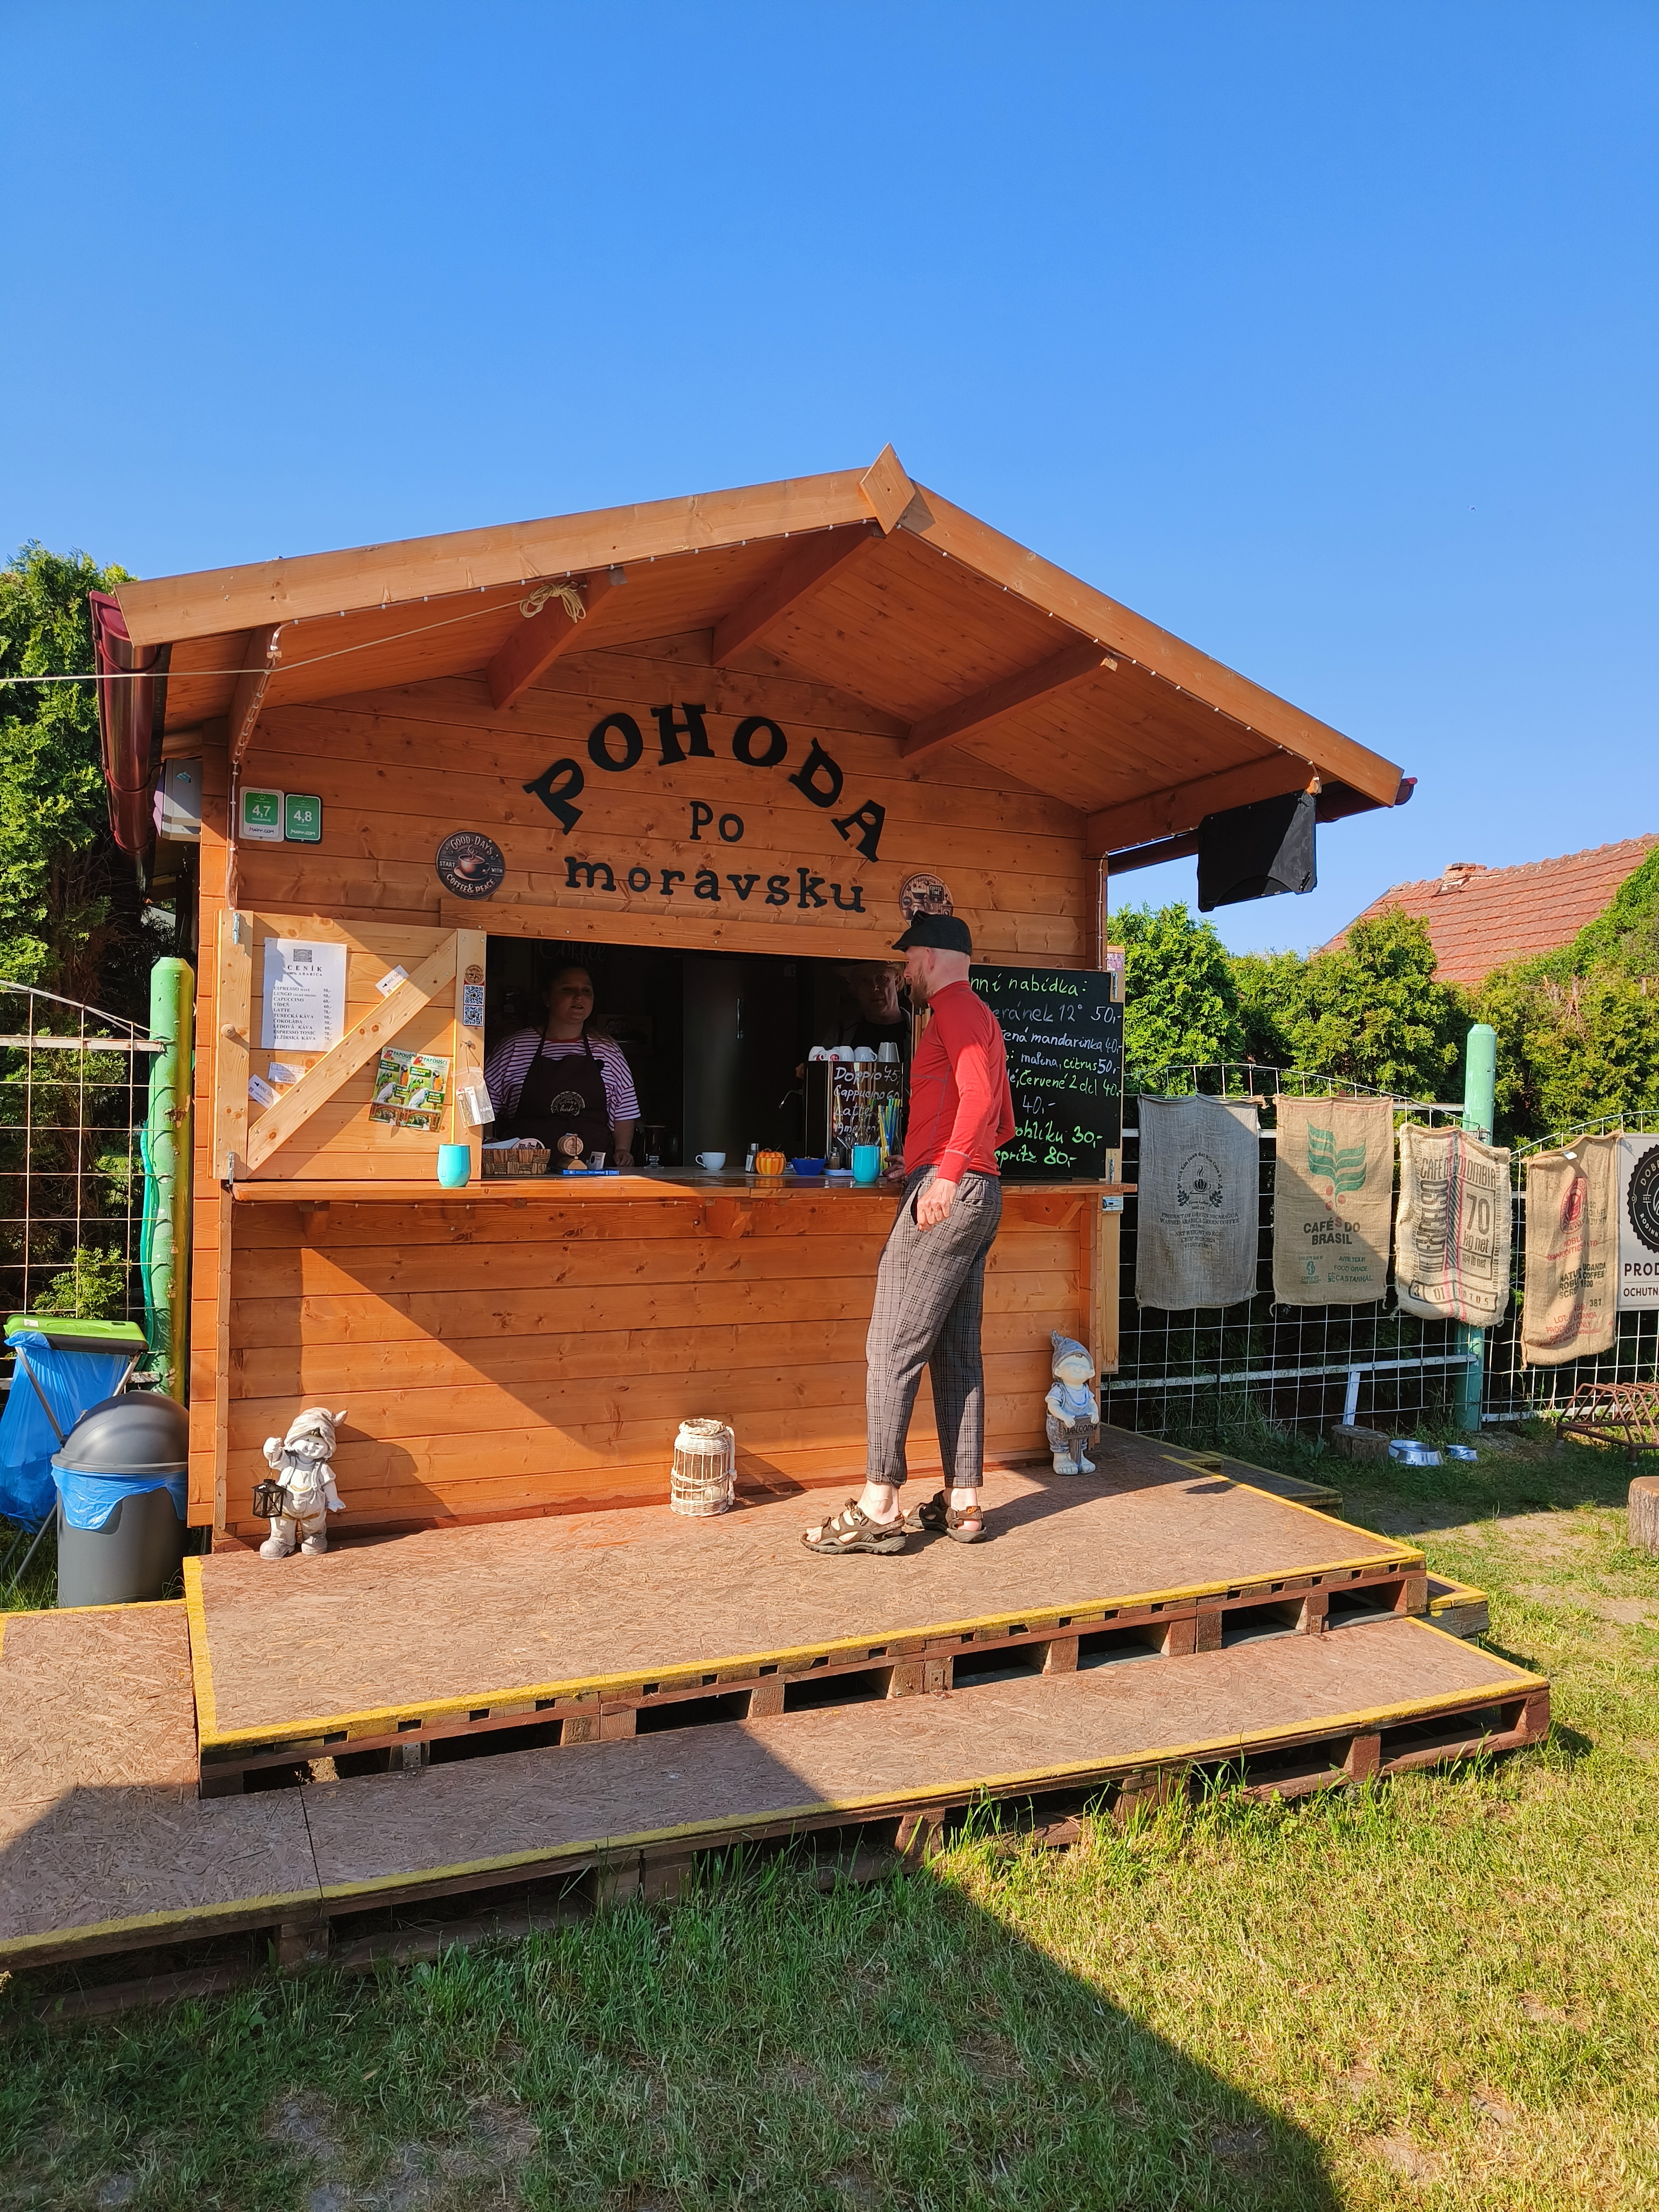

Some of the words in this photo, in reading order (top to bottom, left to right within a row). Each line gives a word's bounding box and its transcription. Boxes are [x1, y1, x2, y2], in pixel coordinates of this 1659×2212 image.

[522, 702, 886, 862] POHODA
[252, 805, 271, 818] 4,7
[293, 810, 312, 823] 4,8
[689, 801, 744, 842] Po
[450, 836, 470, 849] GOOD
[474, 836, 494, 855] DAYS
[447, 874, 468, 892] COFFEE
[467, 884, 474, 893] &
[475, 878, 496, 893] PEACE
[564, 857, 866, 914] moravsku
[1009, 974, 1088, 996] nabídka:
[987, 1001, 1054, 1022] eránek
[1002, 1027, 1029, 1042] ená
[1031, 1033, 1103, 1053] mandarinka
[1063, 1057, 1097, 1071] citrus
[834, 1067, 882, 1085] Doppio
[1069, 1075, 1078, 1089] 2
[835, 1102, 871, 1116] Latte
[1022, 1095, 1056, 1115] 40,-
[1015, 1119, 1064, 1144] ohlíku
[1071, 1125, 1103, 1149] 30,-
[1044, 1145, 1078, 1168] 80,-
[1188, 1153, 1198, 1162] Juan
[1420, 1157, 1442, 1180] CAFE
[1467, 1192, 1491, 1235] 70
[1303, 1217, 1343, 1233] CAFÉS
[1344, 1222, 1361, 1232] DO
[1640, 1213, 1659, 1238] RODINN
[1312, 1232, 1353, 1245] BRASIL
[1463, 1230, 1474, 1250] kg
[1474, 1237, 1489, 1253] net
[1471, 1255, 1476, 1266] lb
[1476, 1258, 1486, 1269] net
[1582, 1262, 1606, 1271] UGANDA
[1582, 1270, 1605, 1279] COFFEE
[1623, 1287, 1659, 1297] OCHUTN
[1063, 1424, 1097, 1435] welcome
